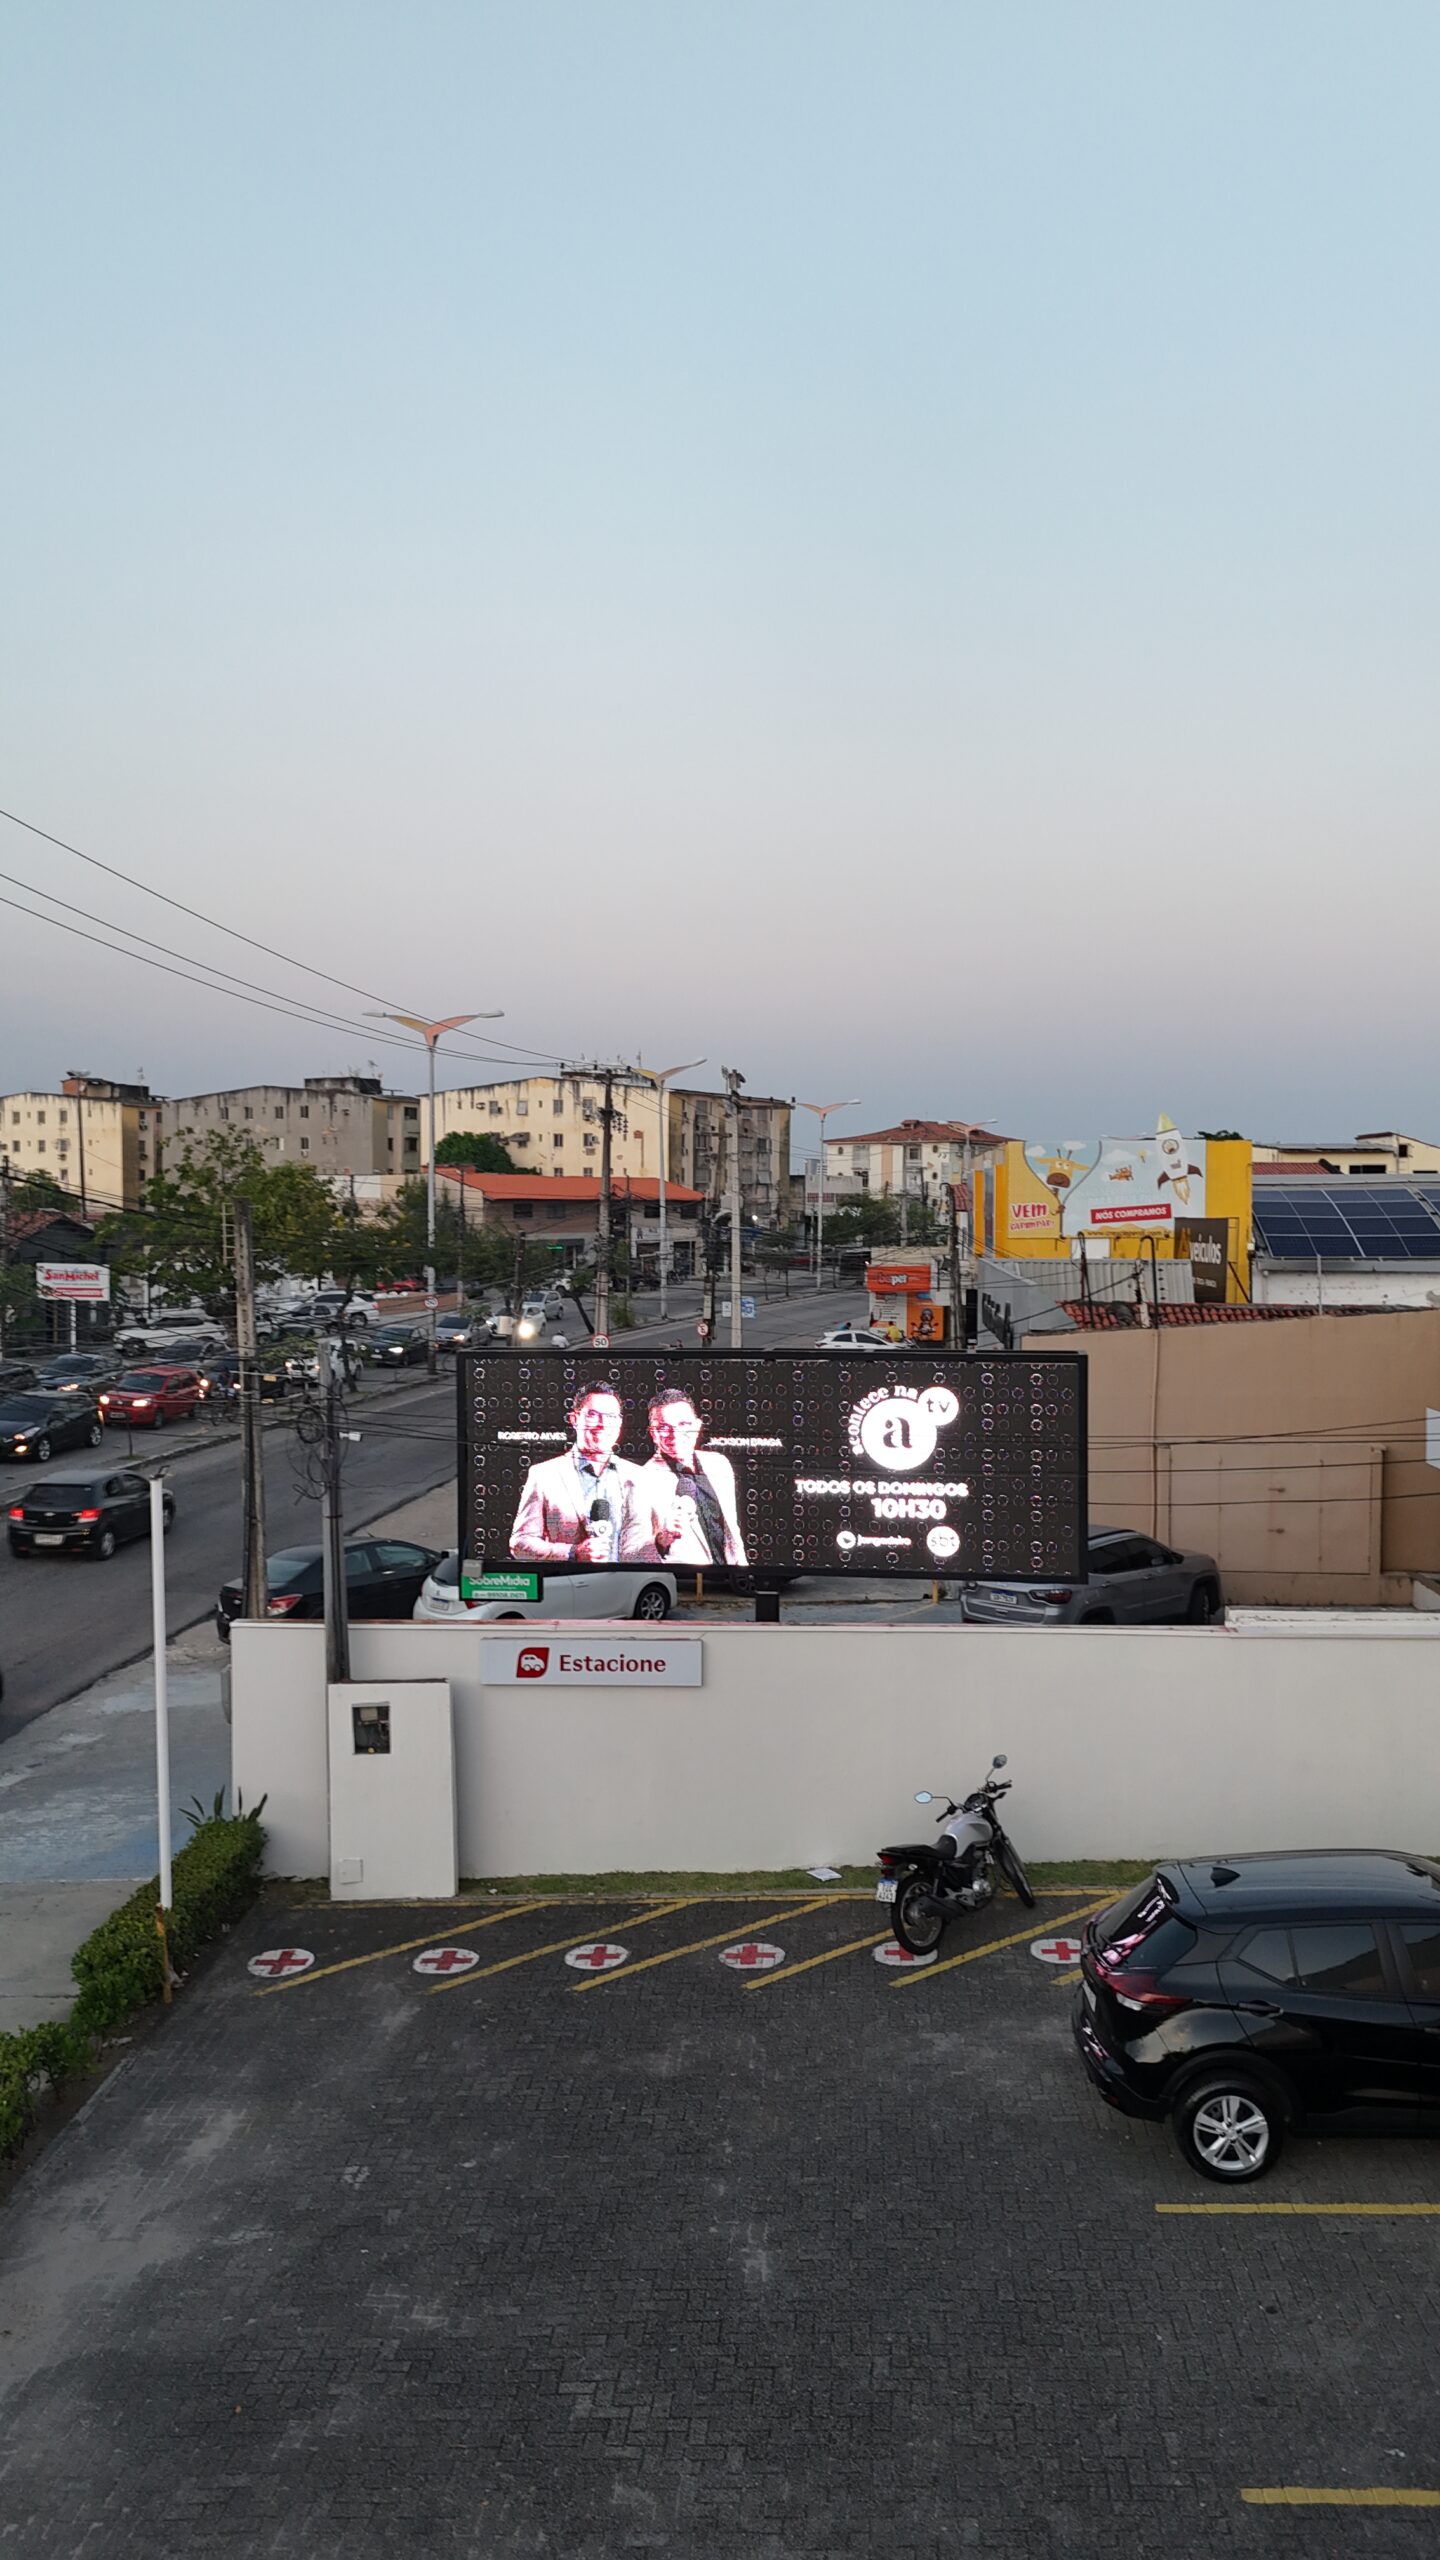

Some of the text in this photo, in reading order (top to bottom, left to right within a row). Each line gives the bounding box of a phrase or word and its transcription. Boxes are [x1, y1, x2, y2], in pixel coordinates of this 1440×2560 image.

[1012, 1204, 1047, 1218] VEM
[1095, 1206, 1168, 1221] NÓS COMPRAMOS
[594, 1338, 607, 1346] 50
[926, 1397, 950, 1414] tv
[848, 1385, 918, 1457] acontece na
[497, 1431, 568, 1441] ROBERTO ALVES
[882, 1416, 913, 1449] a
[794, 1479, 970, 1498] TODOS OS DOMINGOS
[870, 1498, 948, 1521] 10H30
[559, 1654, 666, 1673] Estacione
